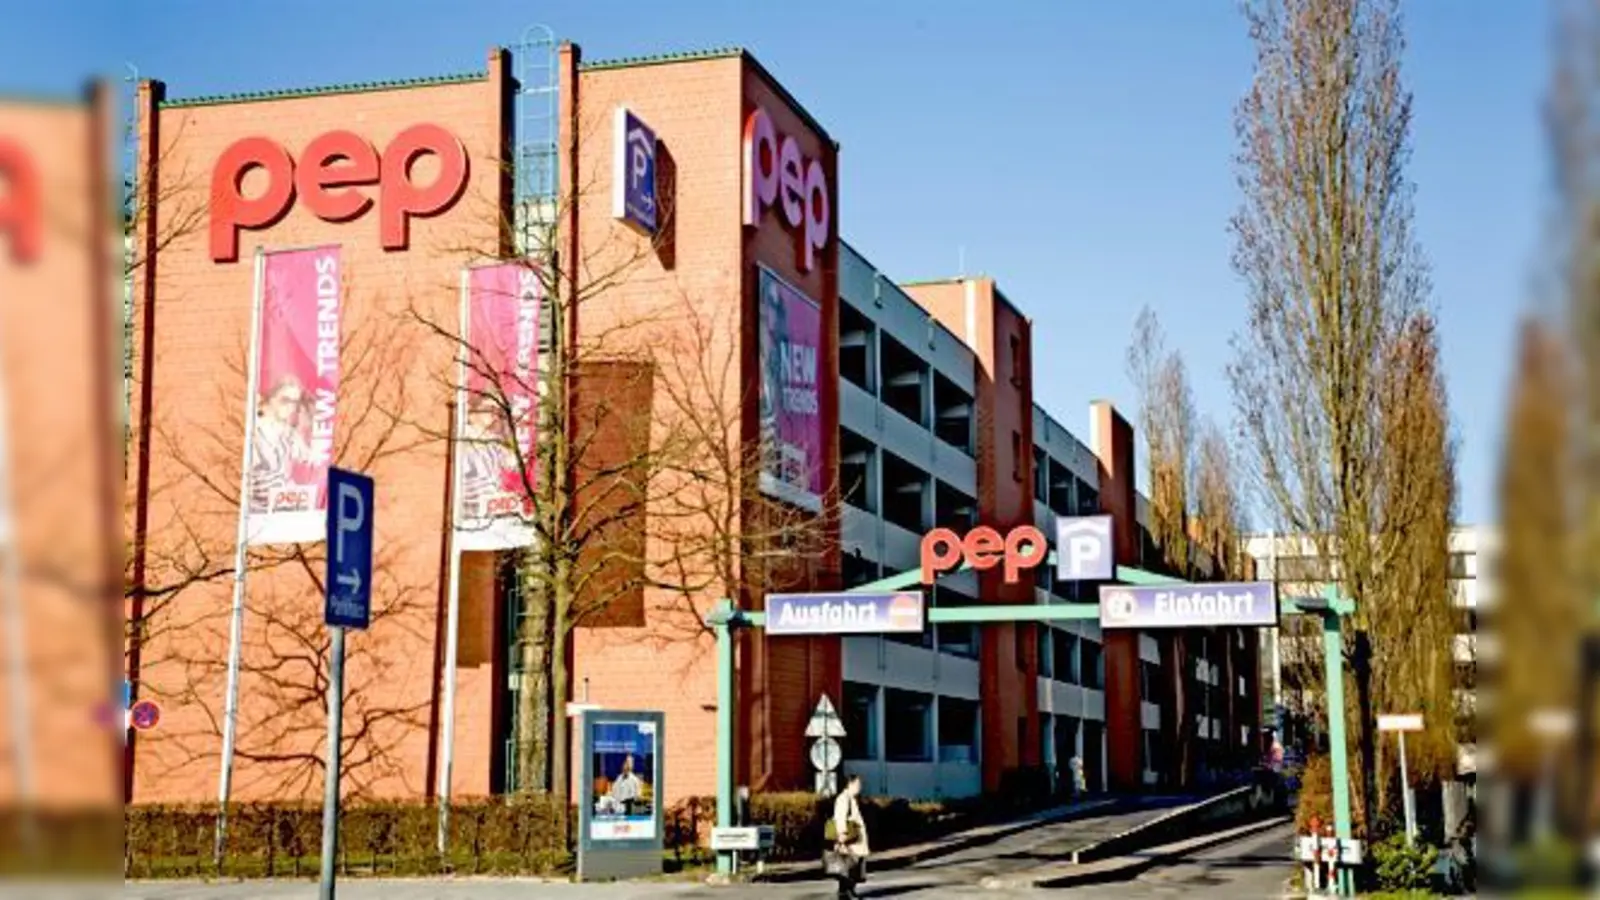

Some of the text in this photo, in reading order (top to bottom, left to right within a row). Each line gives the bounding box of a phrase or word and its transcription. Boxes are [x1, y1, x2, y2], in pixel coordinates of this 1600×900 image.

[209, 123, 468, 262] pep
[632, 144, 647, 189] P
[743, 107, 829, 272] pep
[311, 255, 339, 467] NEW TRENDS
[781, 340, 817, 387] NEW
[336, 481, 364, 563] P
[921, 524, 1047, 585] pep
[1070, 537, 1101, 578] P
[778, 600, 877, 627] Ausfahrt
[1154, 589, 1254, 617] Einfahrt
